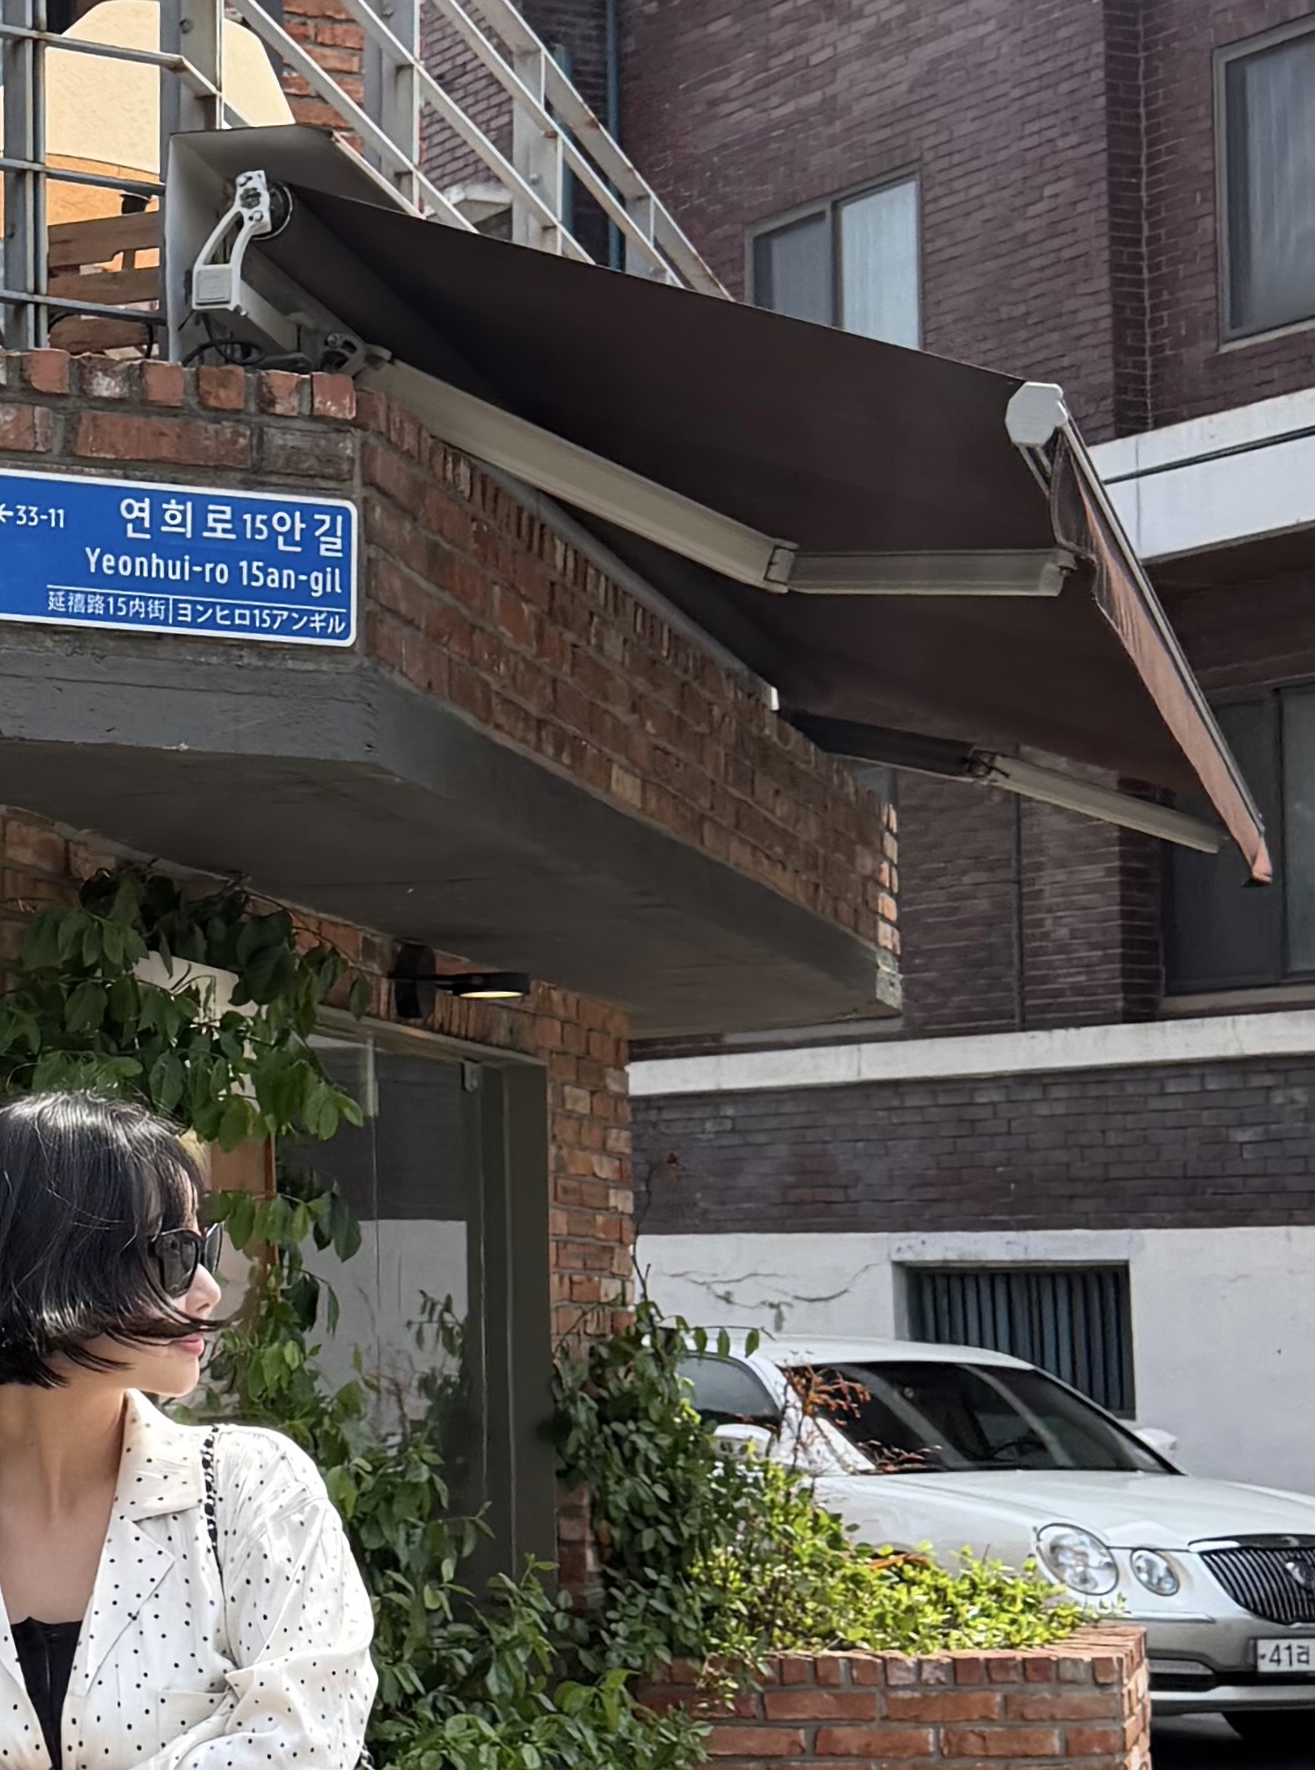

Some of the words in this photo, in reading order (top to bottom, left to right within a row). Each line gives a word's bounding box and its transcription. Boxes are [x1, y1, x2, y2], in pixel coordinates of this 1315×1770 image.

[16, 504, 65, 528] 33-11
[85, 547, 229, 584] Yeonhui-ro
[239, 560, 342, 598] 15an-gil
